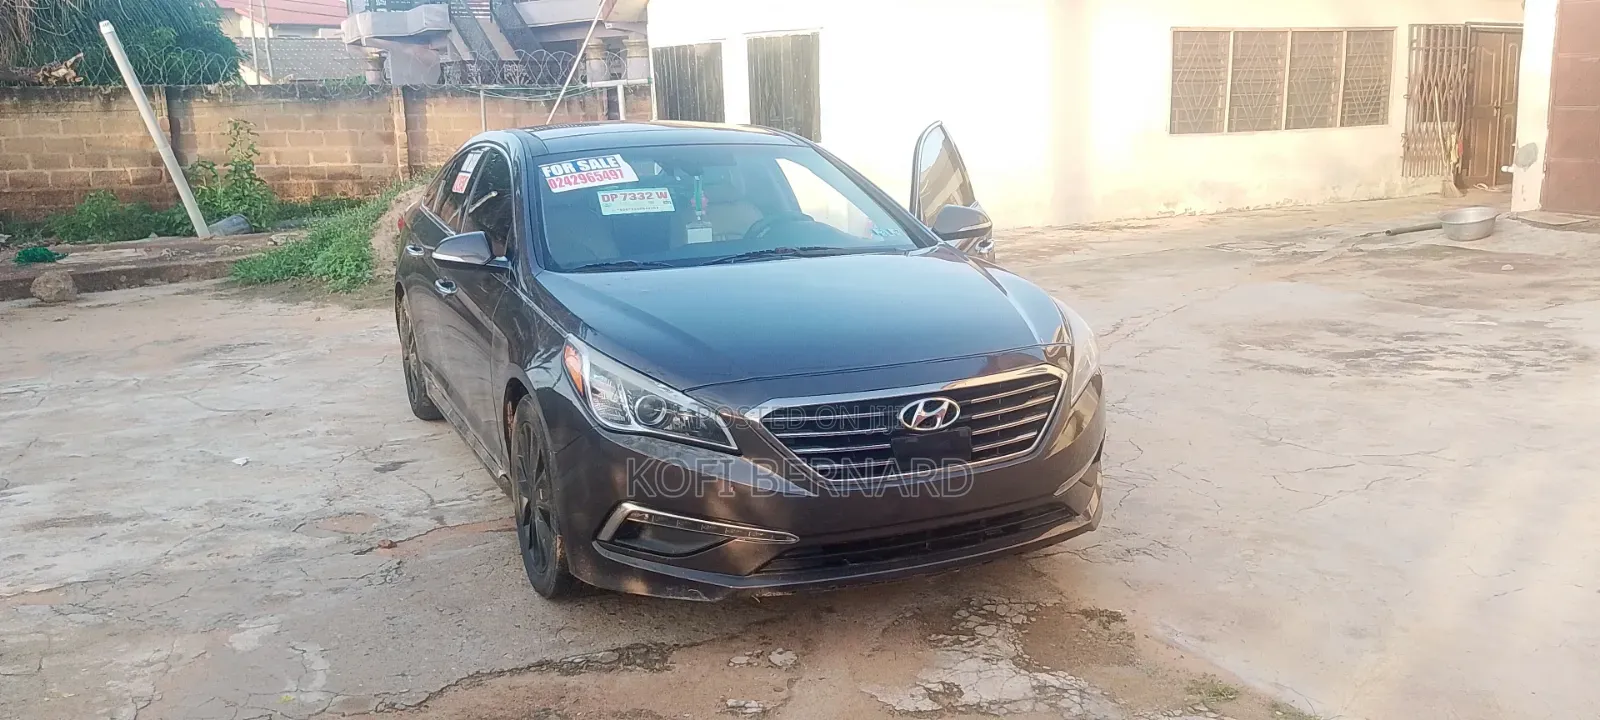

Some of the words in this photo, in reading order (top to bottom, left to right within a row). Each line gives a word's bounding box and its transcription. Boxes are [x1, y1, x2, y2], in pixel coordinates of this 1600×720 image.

[541, 162, 576, 178] FOR
[577, 156, 620, 172] SALE
[547, 169, 624, 189] 0242965497
[601, 193, 618, 202] DP
[620, 192, 654, 201] 7332
[656, 191, 668, 199] W
